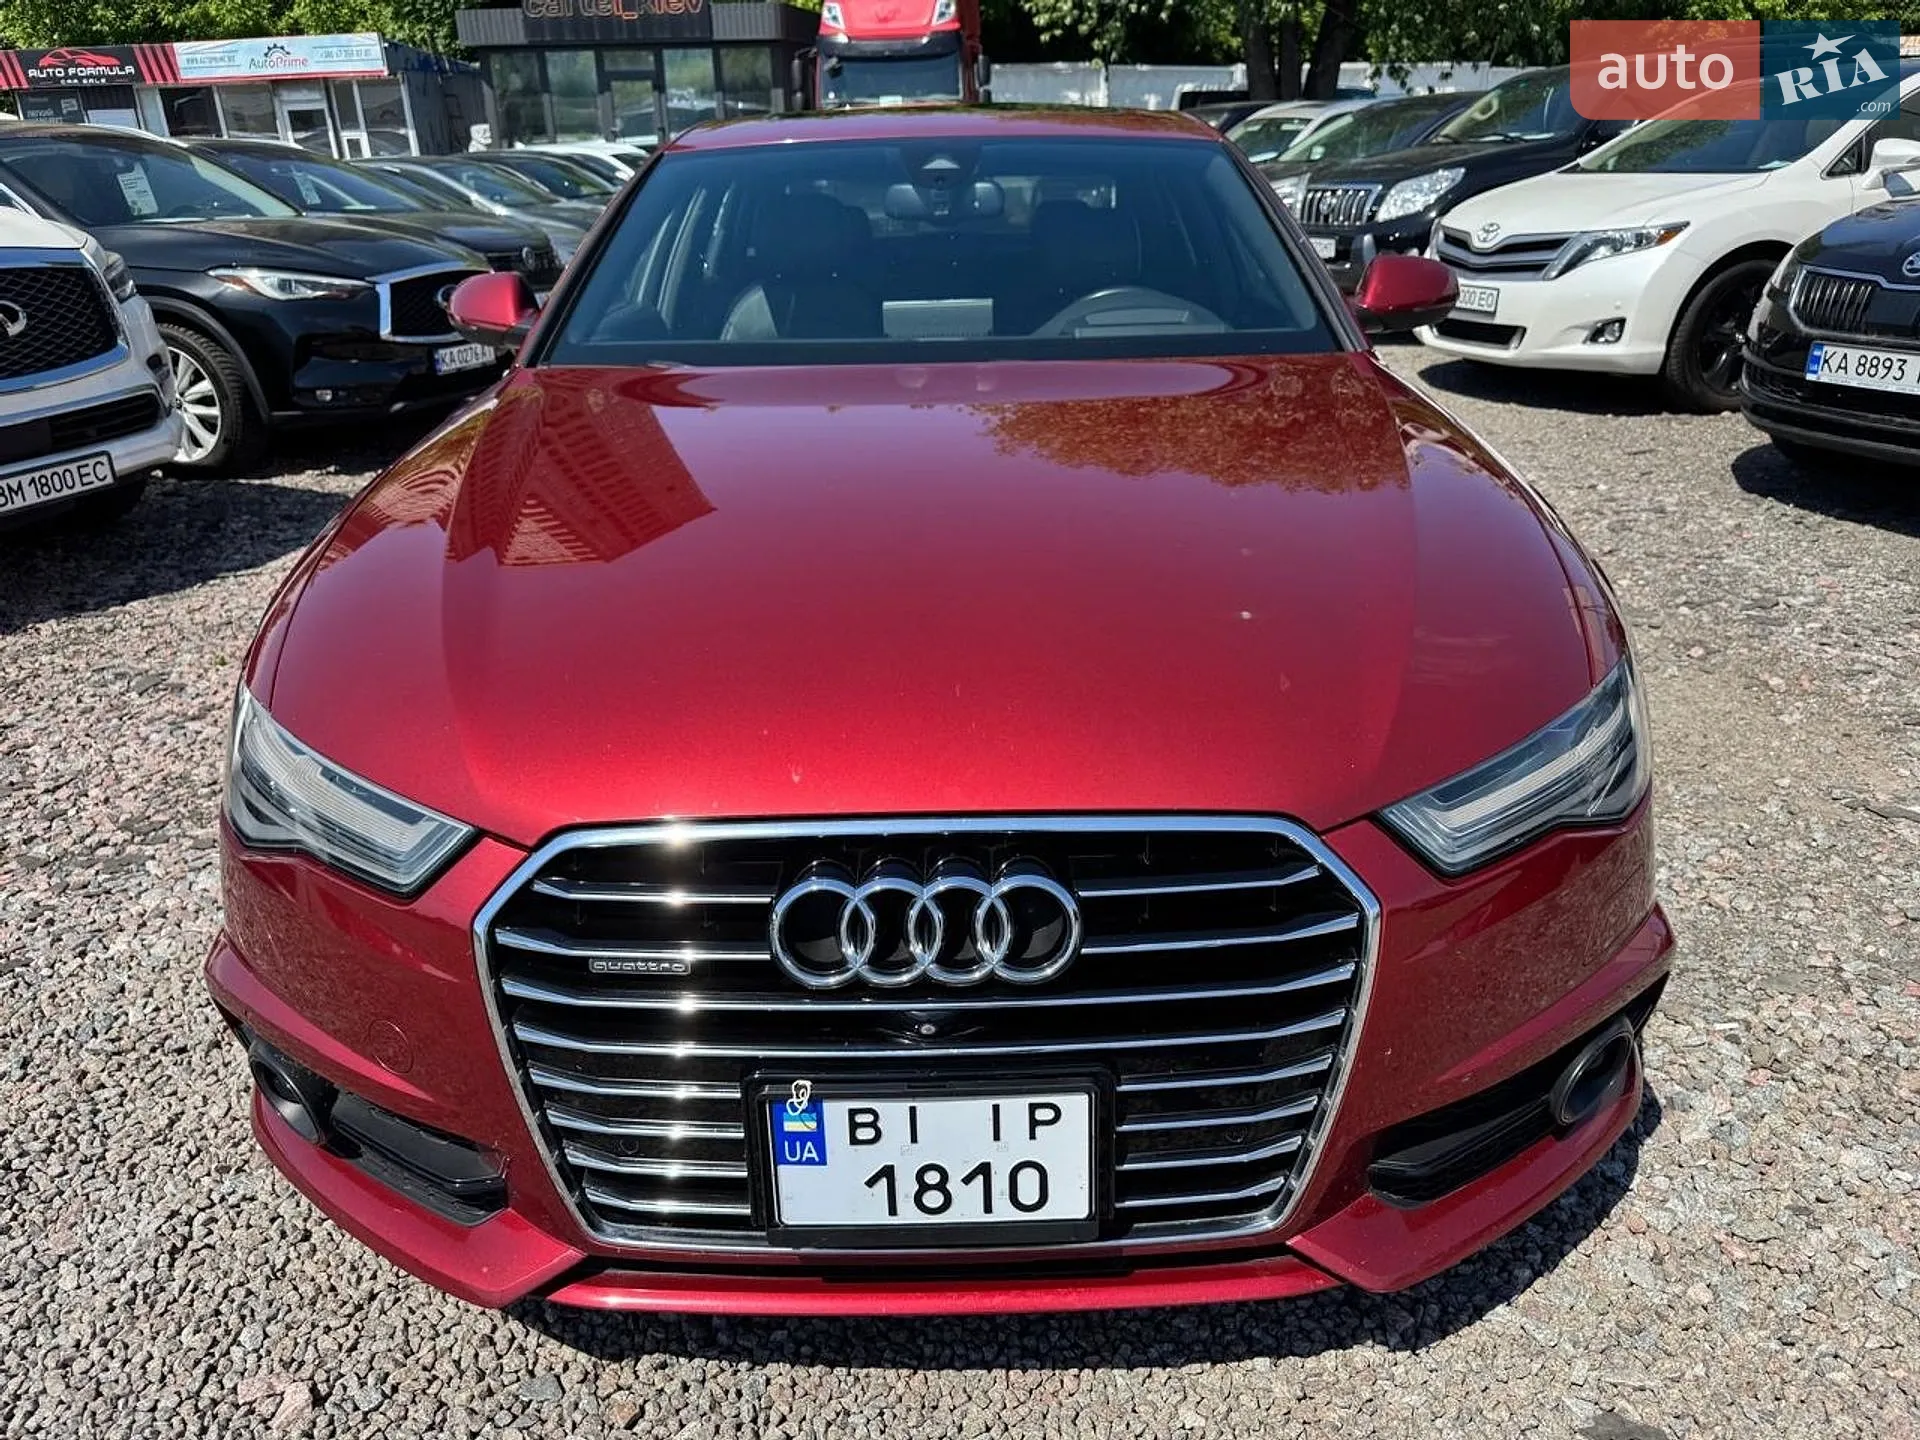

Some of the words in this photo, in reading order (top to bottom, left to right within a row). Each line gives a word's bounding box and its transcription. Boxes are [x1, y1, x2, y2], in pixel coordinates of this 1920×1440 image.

[28, 68, 65, 78] AUTO
[68, 65, 135, 77] FORMULA
[248, 56, 309, 69] AutoPrime
[1821, 350, 1848, 375] KA
[1855, 354, 1907, 381] 8893
[28, 468, 75, 497] 1800
[77, 461, 107, 487] EC
[593, 961, 686, 973] quattro
[848, 1105, 918, 1146] BI
[992, 1102, 1062, 1142] IP
[785, 1140, 819, 1162] UA
[864, 1159, 1050, 1217] 1810
